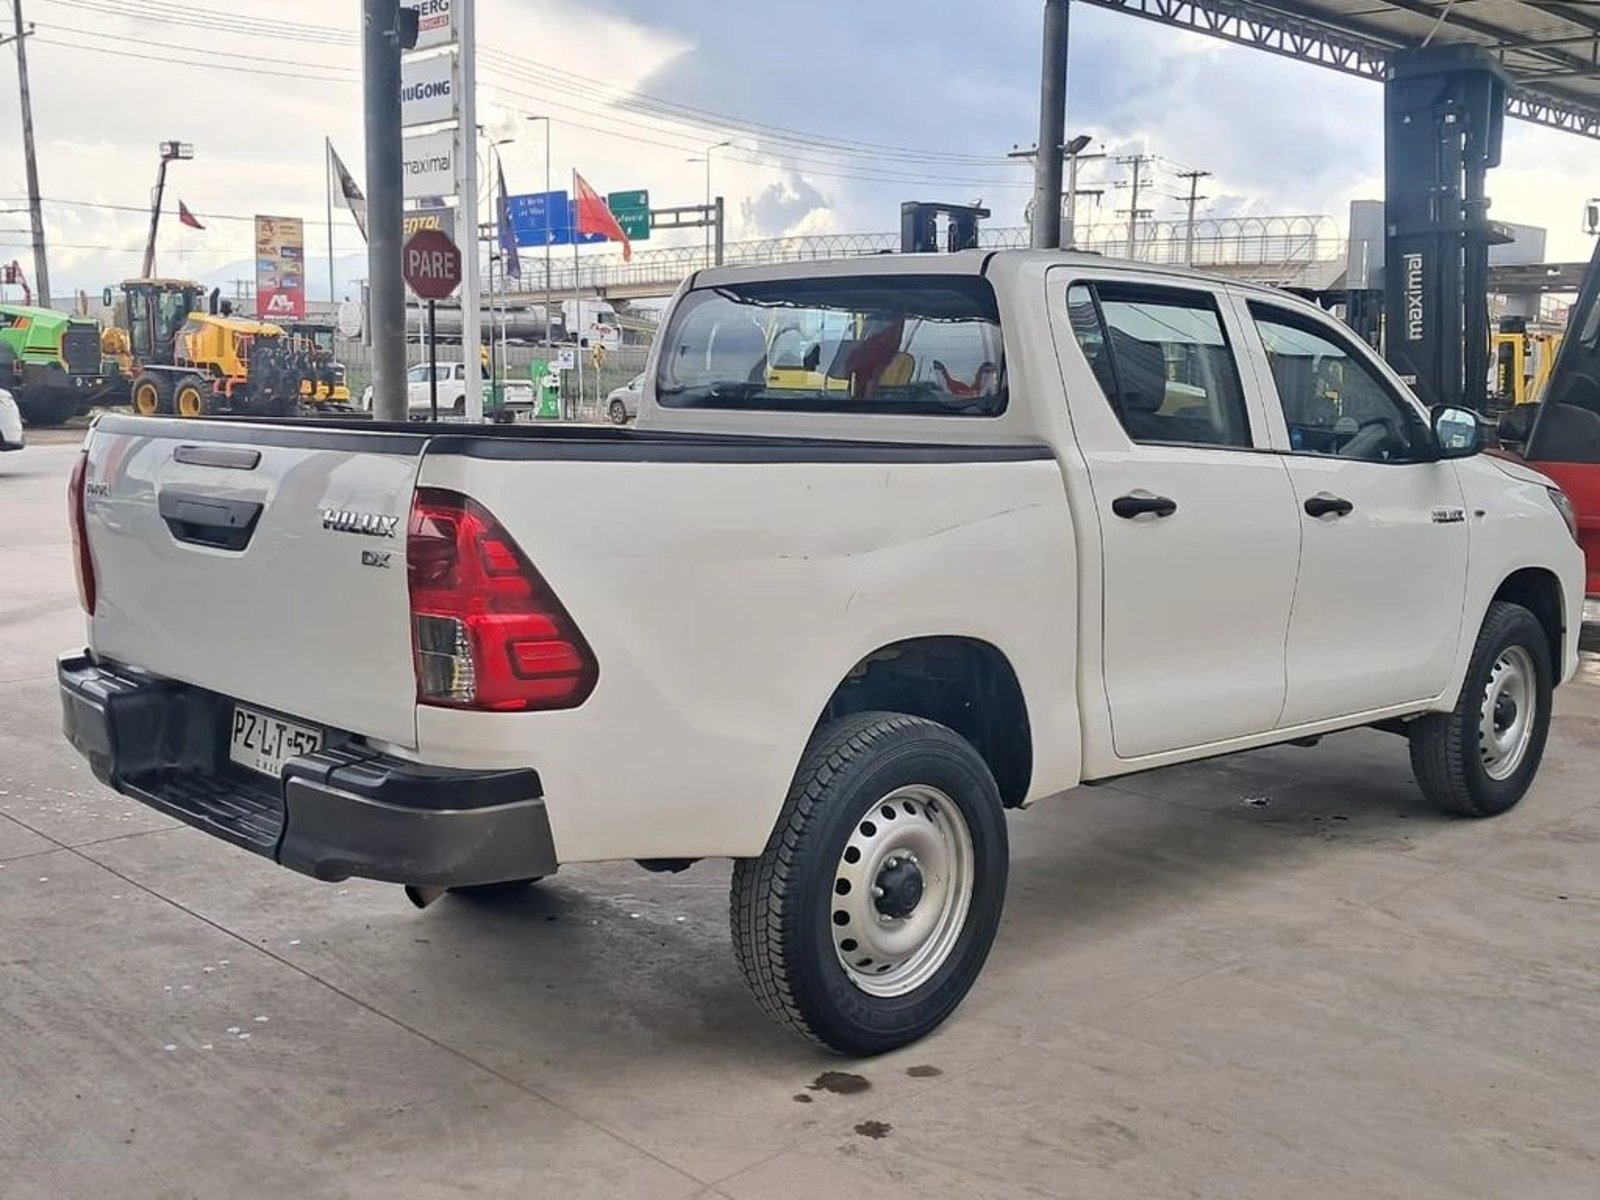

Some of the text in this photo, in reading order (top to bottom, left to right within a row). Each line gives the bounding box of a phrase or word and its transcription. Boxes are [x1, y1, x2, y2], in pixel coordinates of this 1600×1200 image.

[402, 80, 451, 102] IUGONG
[408, 249, 455, 279] PARE
[1403, 253, 1423, 340] maximal
[323, 510, 399, 538] HILUX
[362, 550, 391, 569] DX
